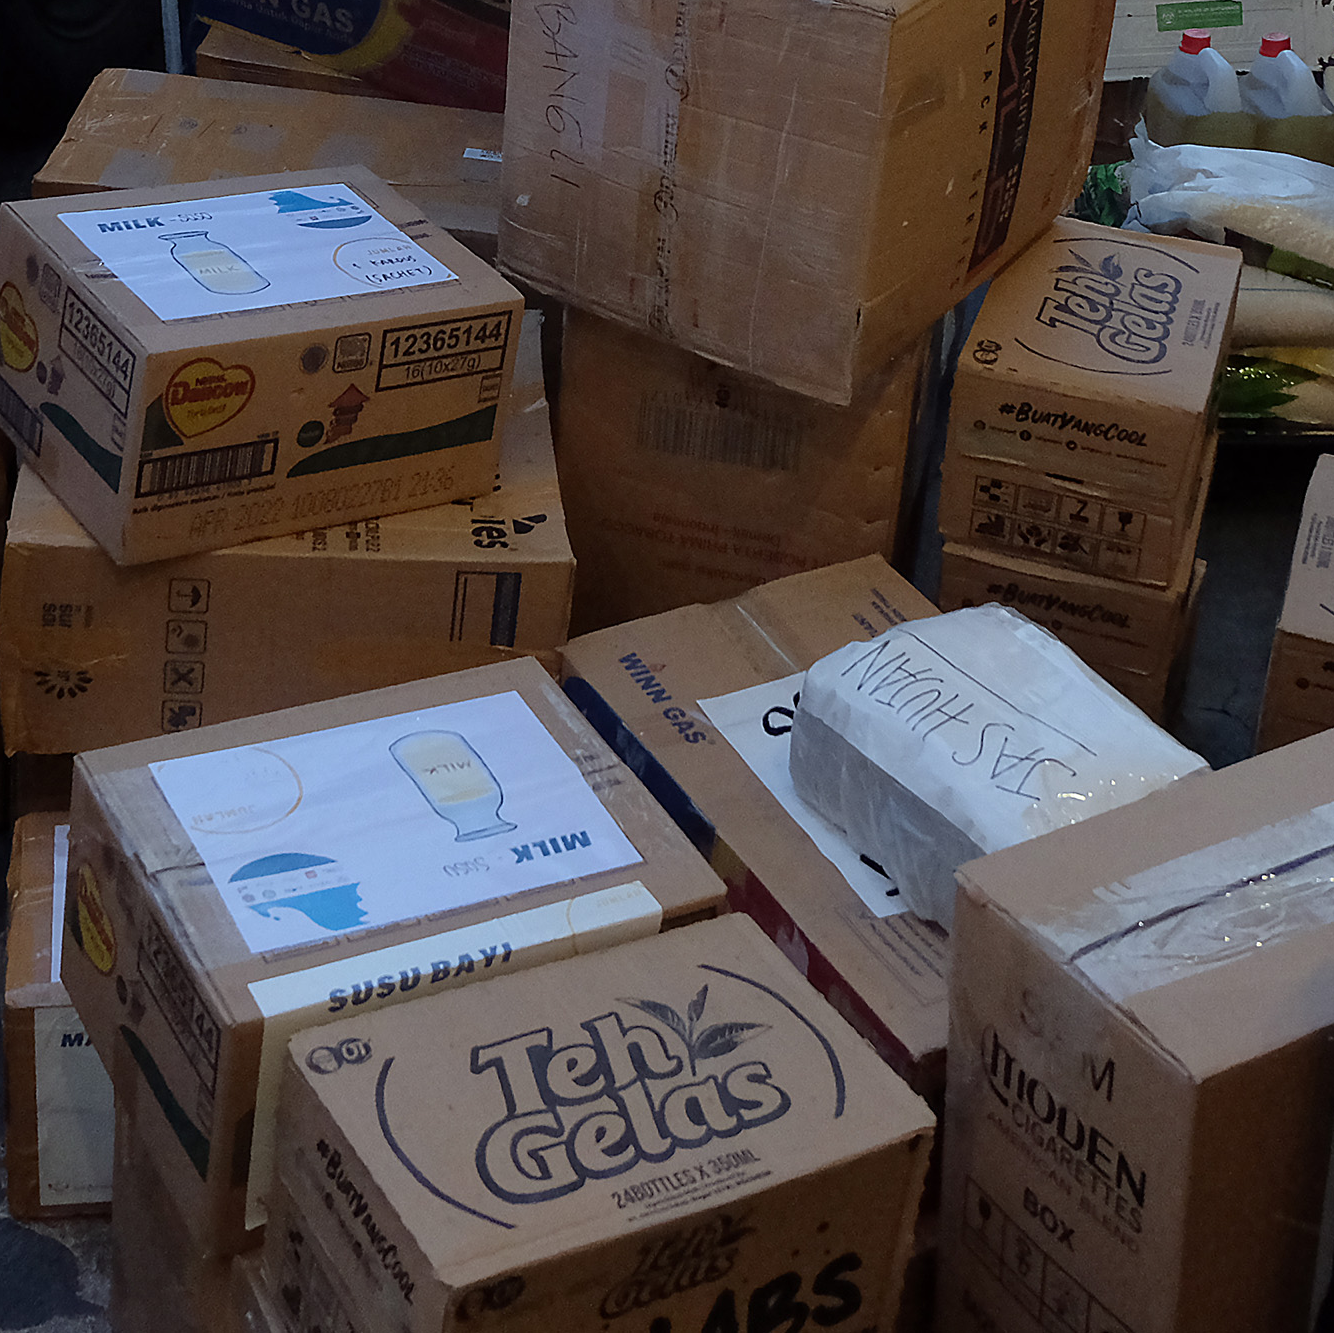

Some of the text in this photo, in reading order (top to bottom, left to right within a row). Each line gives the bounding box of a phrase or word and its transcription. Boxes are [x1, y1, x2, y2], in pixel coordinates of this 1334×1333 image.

[979, 12, 998, 135] BLACK
[1013, 78, 1032, 153] SUPER
[98, 216, 165, 233] MILK
[390, 320, 502, 359] 12365144
[1036, 265, 1122, 337] Teh
[1096, 265, 1183, 365] Gelas
[68, 301, 131, 381] 12365144
[405, 354, 482, 381] 16(10x27g)
[618, 651, 708, 747] WINN GAS
[953, 722, 1077, 801] JAS
[511, 828, 592, 865] MILK
[327, 941, 515, 1015] SUSU BAYI
[470, 1012, 681, 1118] Teh
[475, 1061, 791, 1207] Gelas
[1012, 1102, 1144, 1236] CIGARETTES
[611, 1169, 695, 1210] 24BOTTLES
[708, 1147, 762, 1177] 350ML
[1023, 1186, 1077, 1253] BOX
[647, 1251, 864, 1333] ABS
